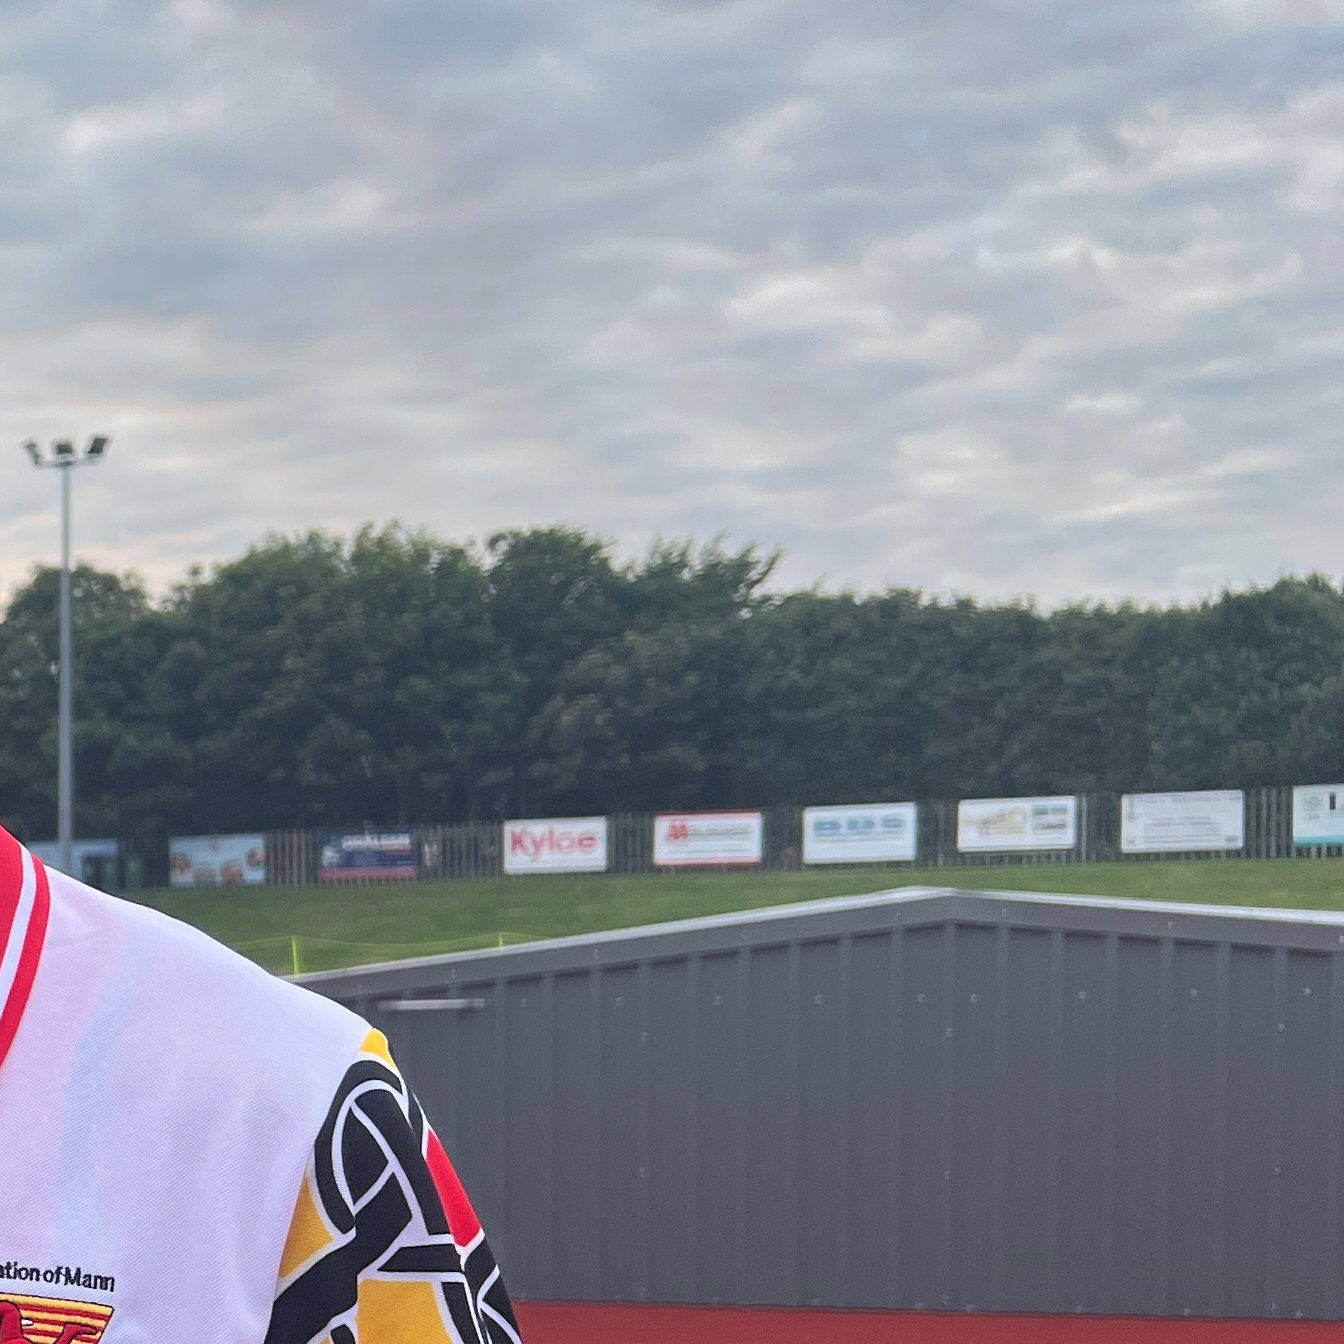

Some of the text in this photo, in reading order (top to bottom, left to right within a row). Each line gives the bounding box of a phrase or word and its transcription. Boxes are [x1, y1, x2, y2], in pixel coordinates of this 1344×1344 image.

[509, 825, 599, 861] Kyloe
[43, 1265, 65, 1285] of
[64, 1266, 115, 1292] Mann
